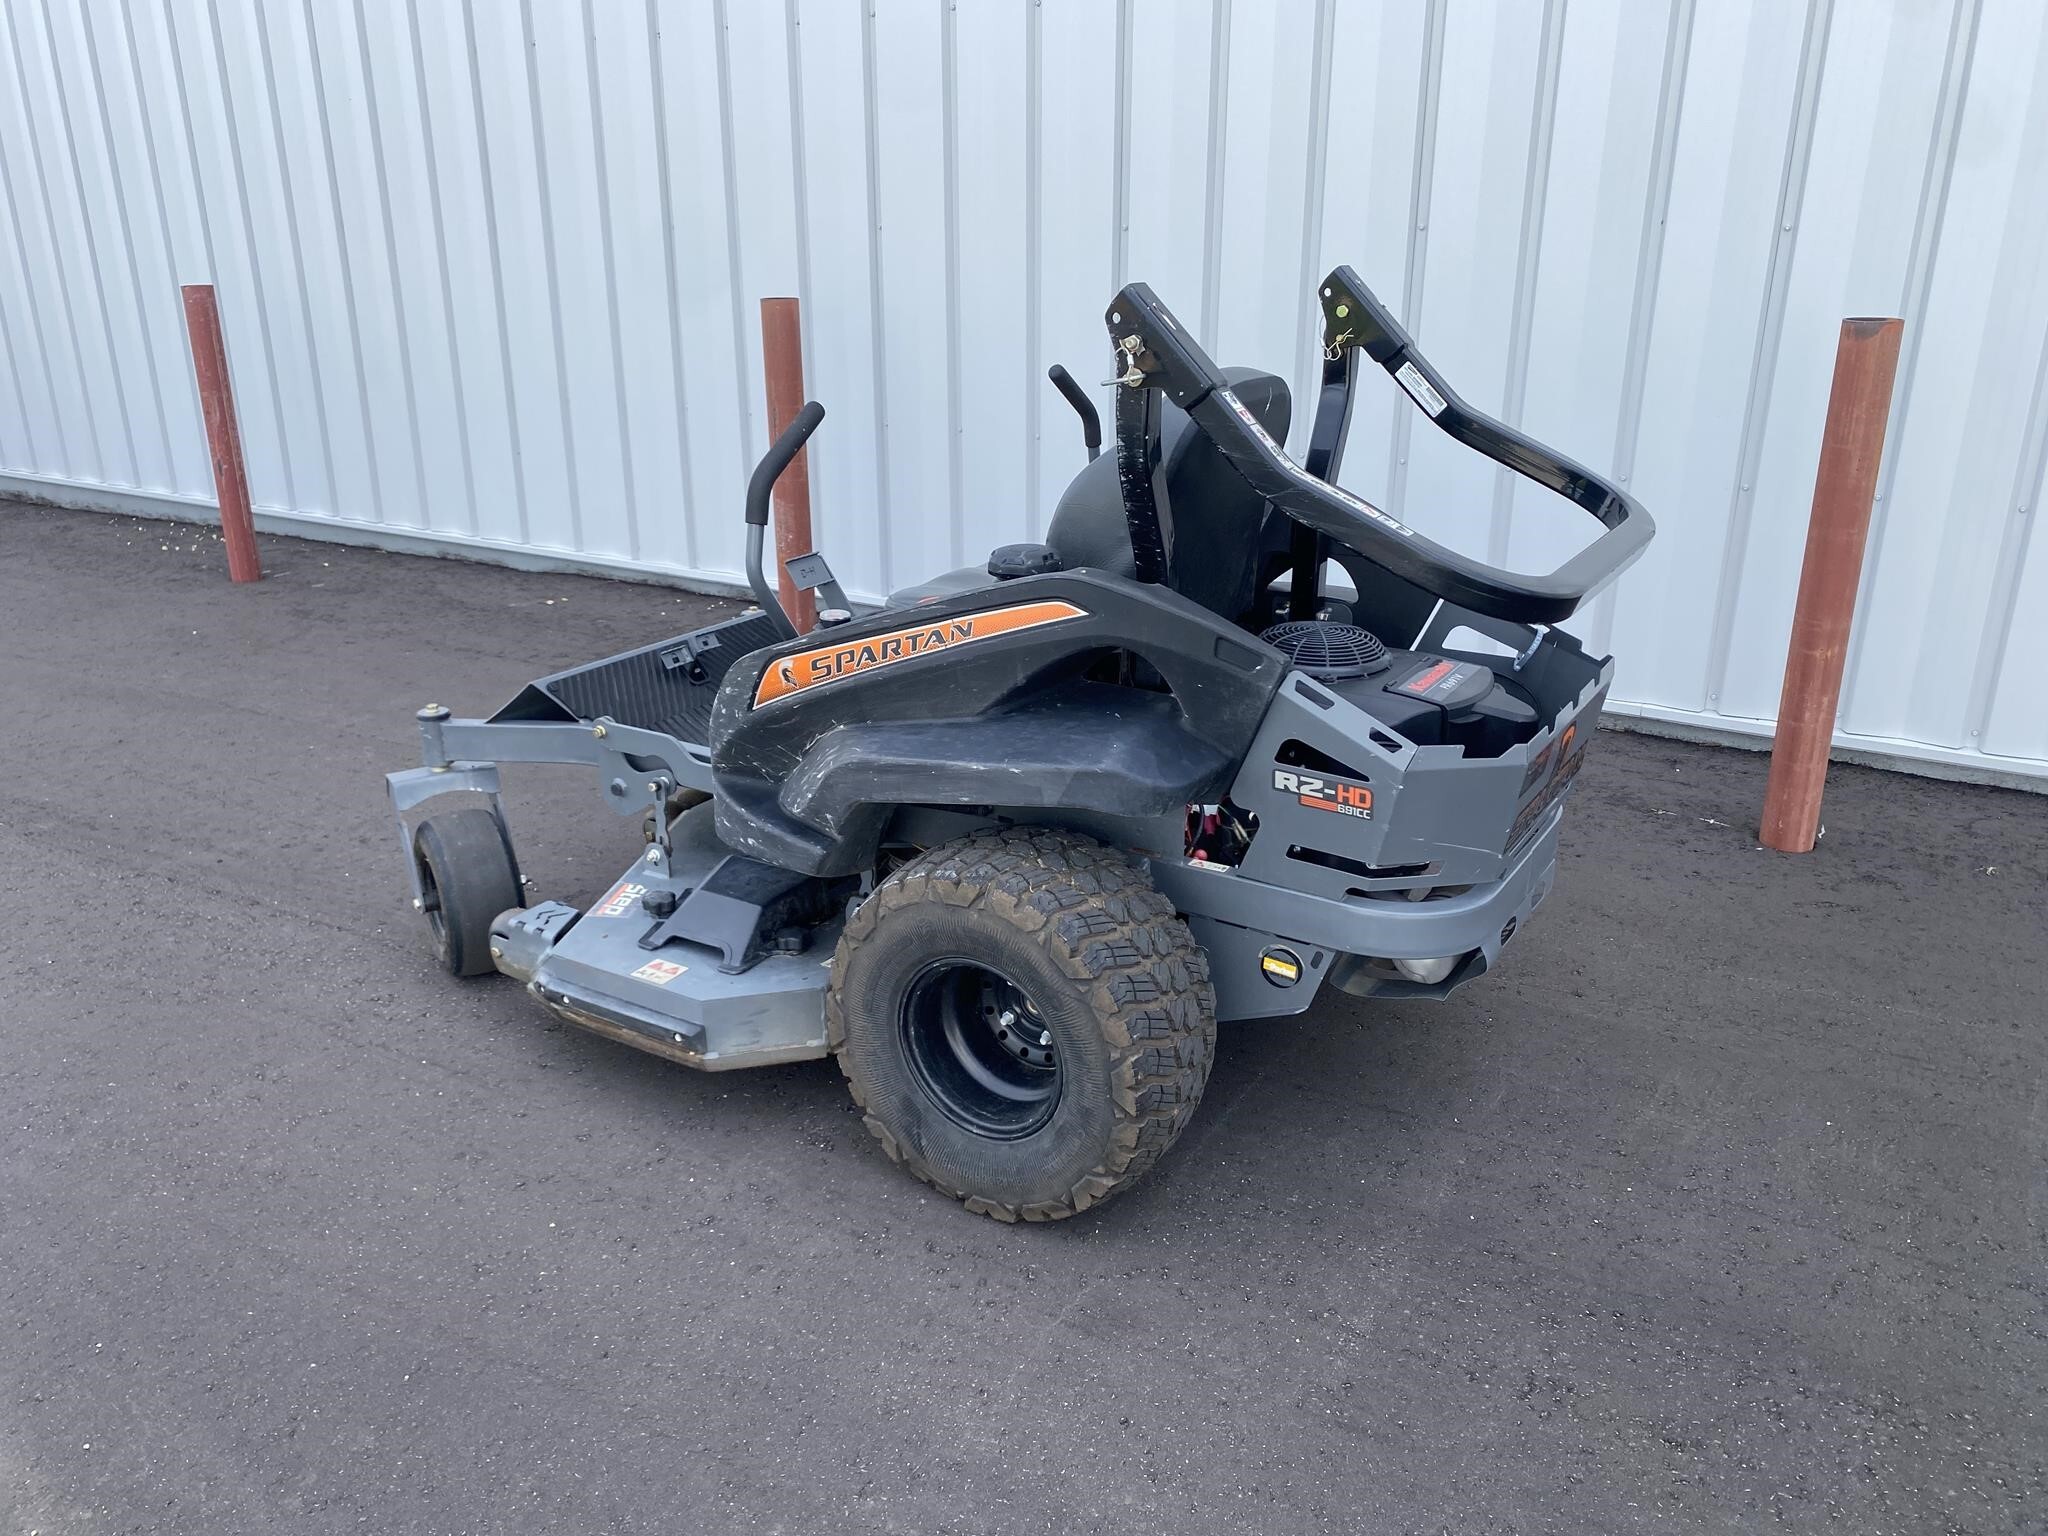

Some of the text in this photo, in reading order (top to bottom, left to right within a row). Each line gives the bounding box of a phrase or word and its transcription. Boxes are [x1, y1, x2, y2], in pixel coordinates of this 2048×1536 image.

[811, 620, 975, 681] SPARTAN
[1337, 804, 1371, 820] 691CC
[597, 882, 648, 915] Step
